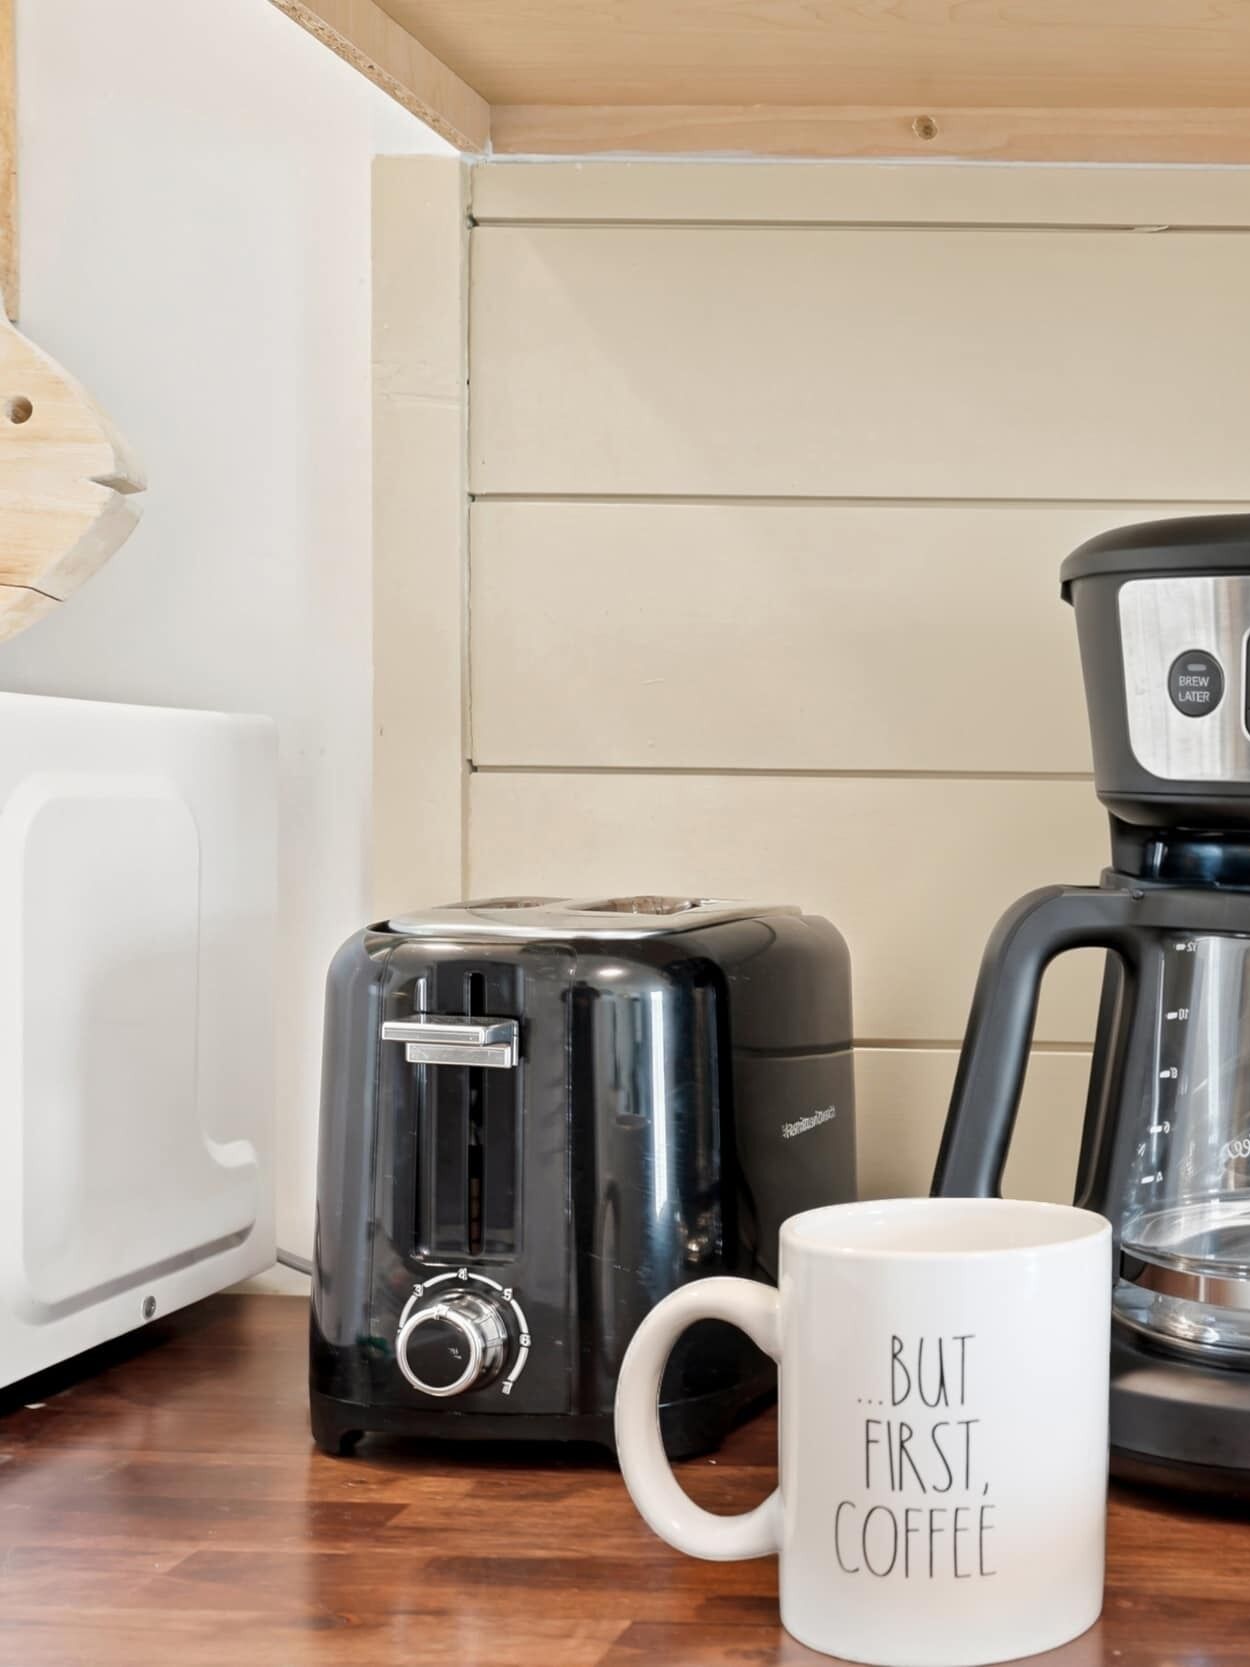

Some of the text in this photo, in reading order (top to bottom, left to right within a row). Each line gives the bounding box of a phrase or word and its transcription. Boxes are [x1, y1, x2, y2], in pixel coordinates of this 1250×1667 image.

[1179, 675, 1210, 687] BREW
[1179, 691, 1210, 703] LATER
[865, 1419, 989, 1496] FIRST,
[835, 1500, 997, 1579] COFFEE
